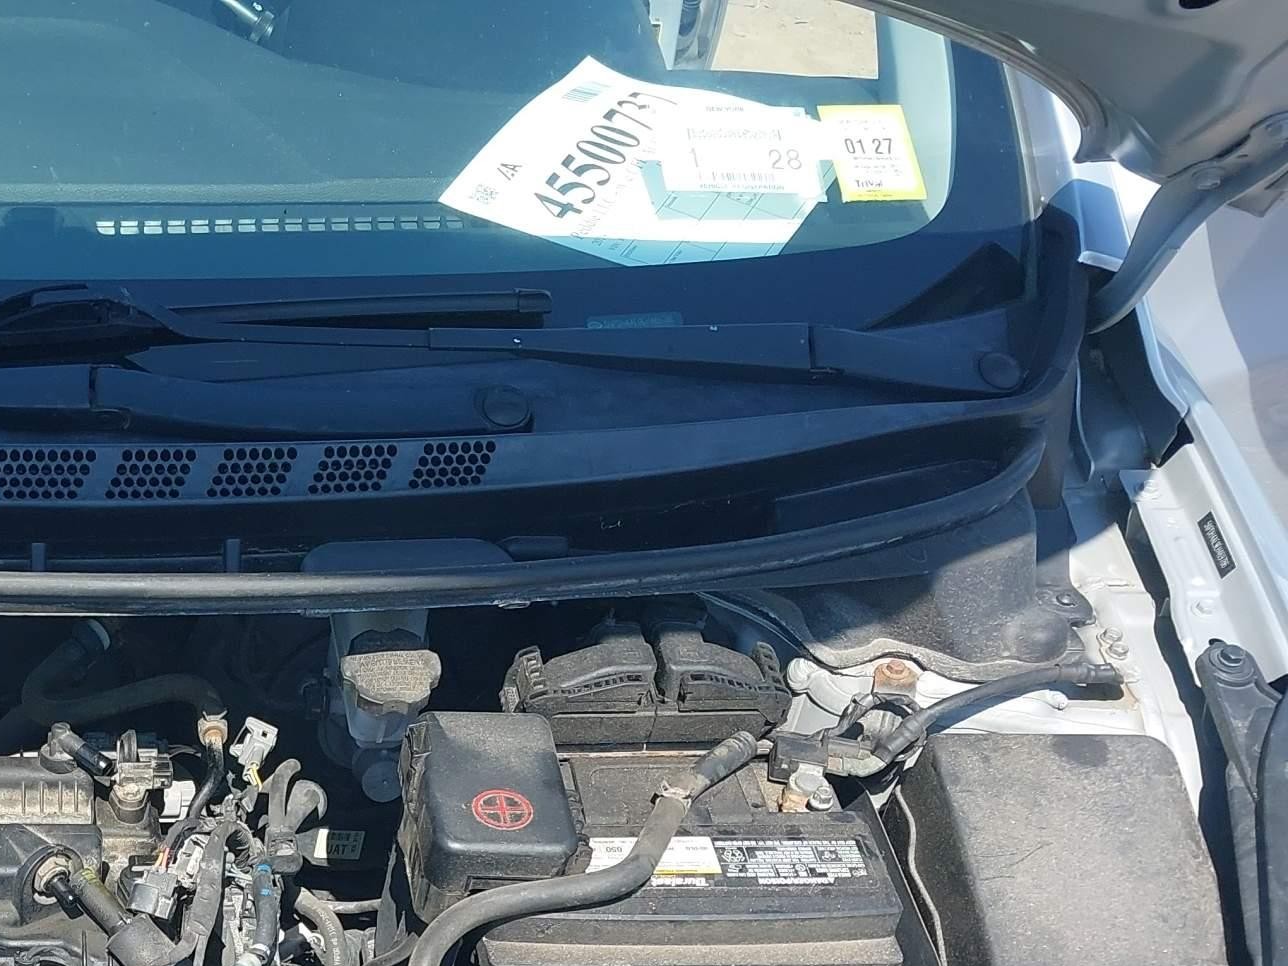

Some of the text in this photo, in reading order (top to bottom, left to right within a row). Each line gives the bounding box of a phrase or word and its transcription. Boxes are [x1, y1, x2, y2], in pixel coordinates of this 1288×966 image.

[844, 138, 892, 155] 01 27
[768, 149, 803, 170] 28
